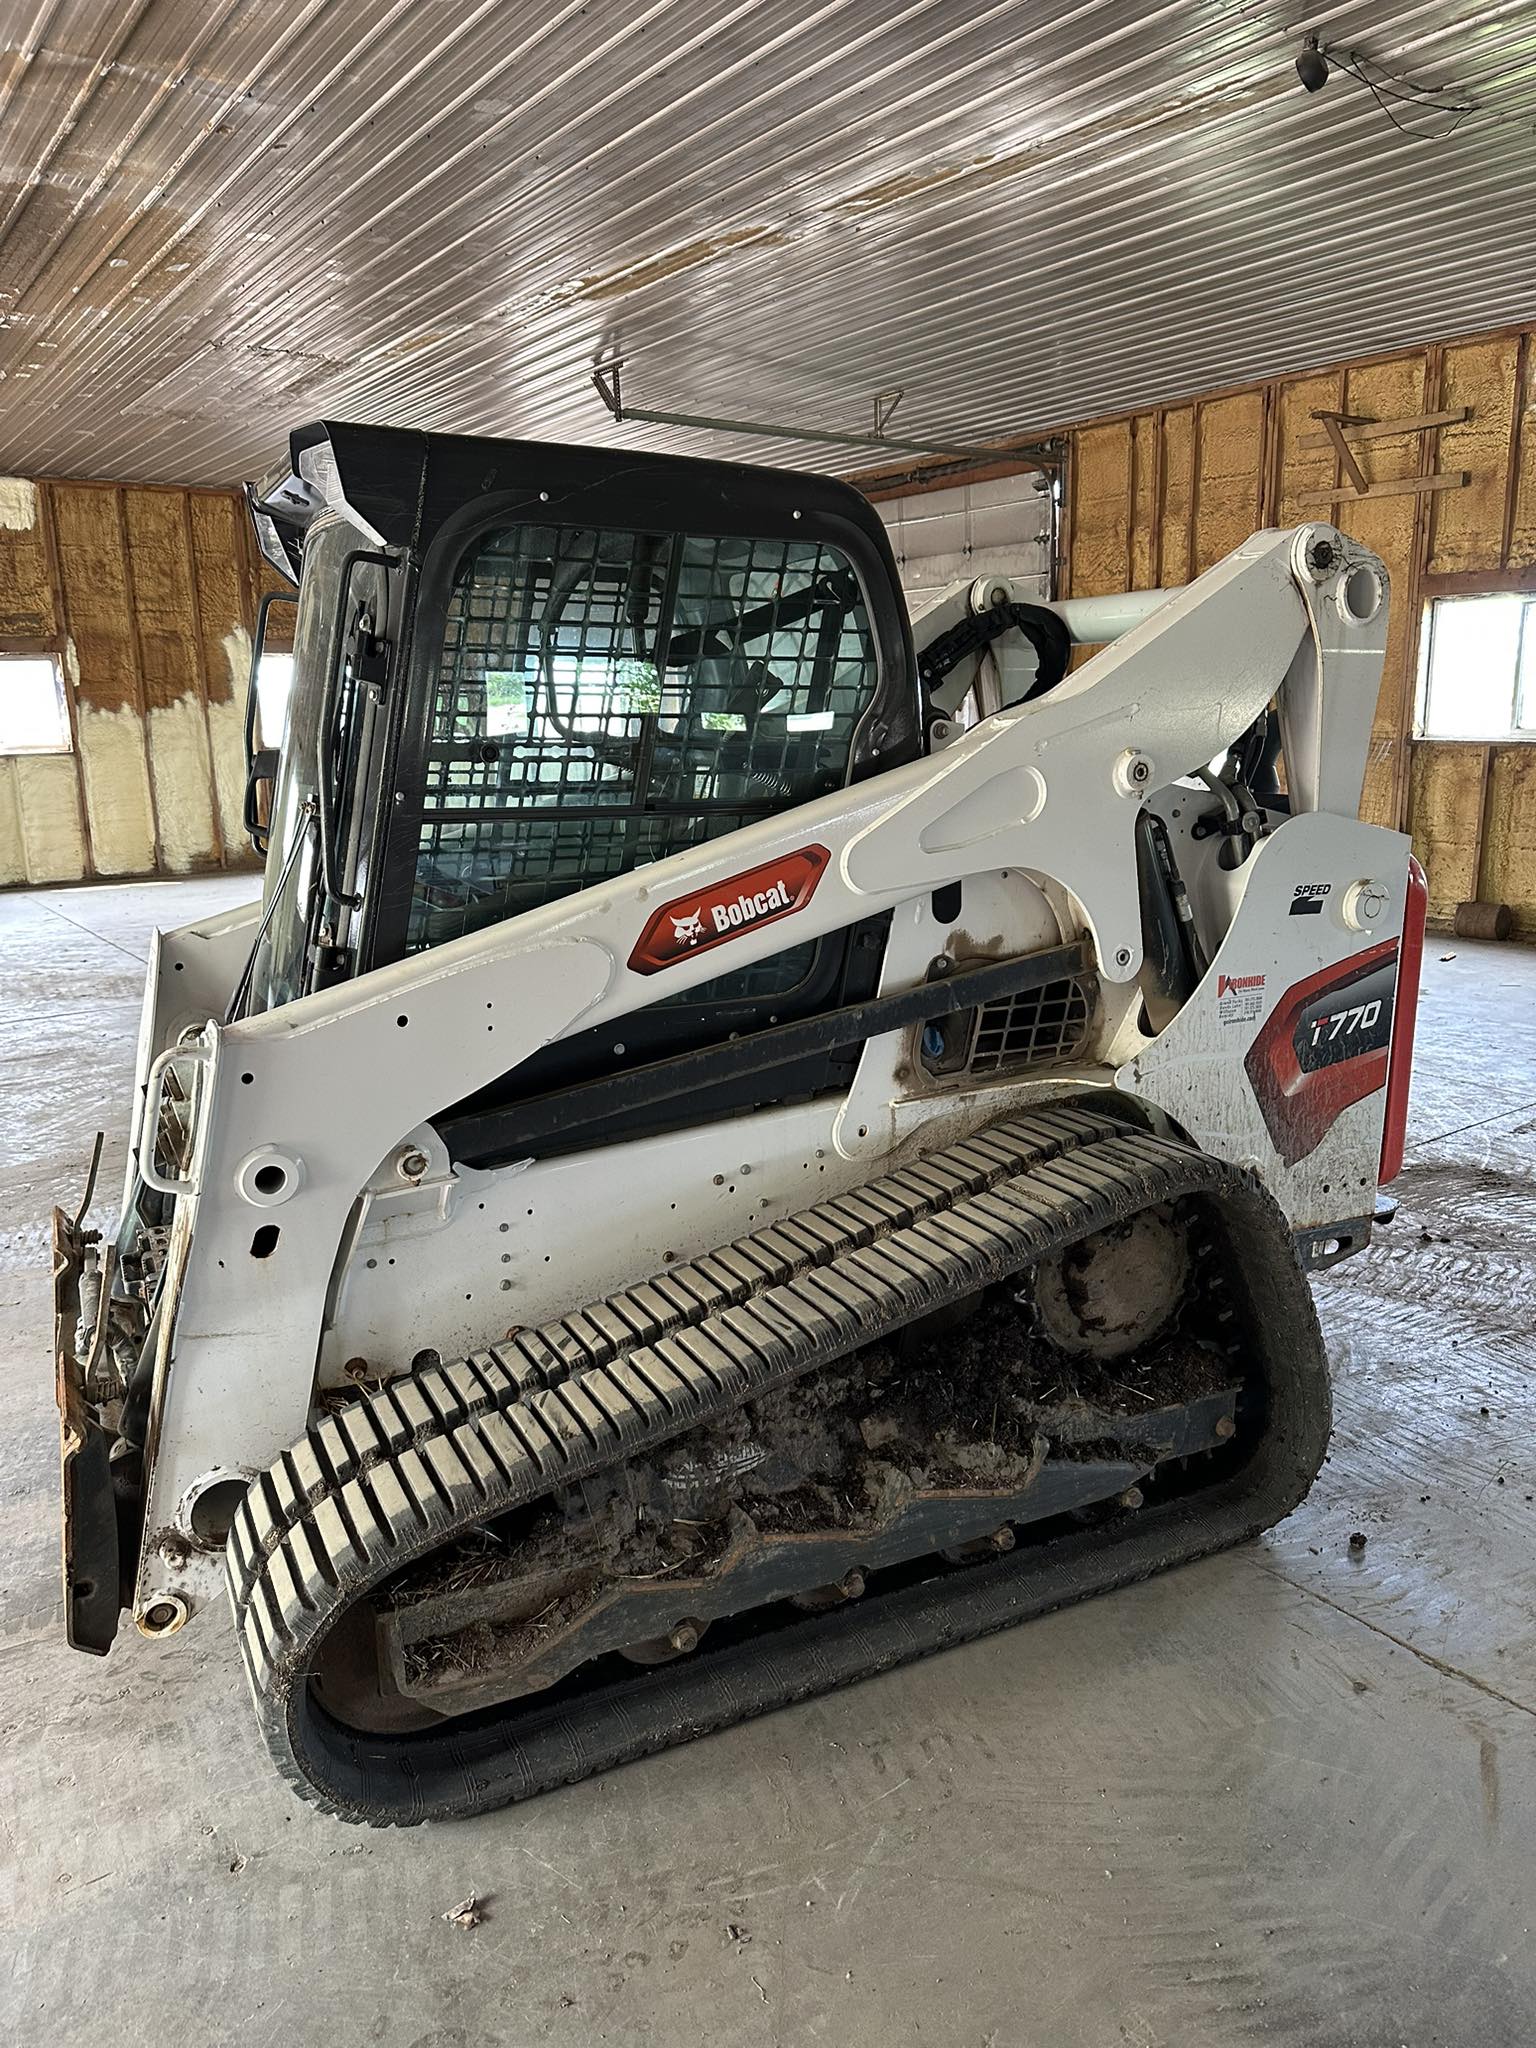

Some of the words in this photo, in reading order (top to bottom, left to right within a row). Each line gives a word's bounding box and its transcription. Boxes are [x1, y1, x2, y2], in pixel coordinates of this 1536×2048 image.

[711, 880, 791, 932] Bobcat
[1294, 884, 1331, 896] SPEED
[1311, 1000, 1382, 1046] T770
